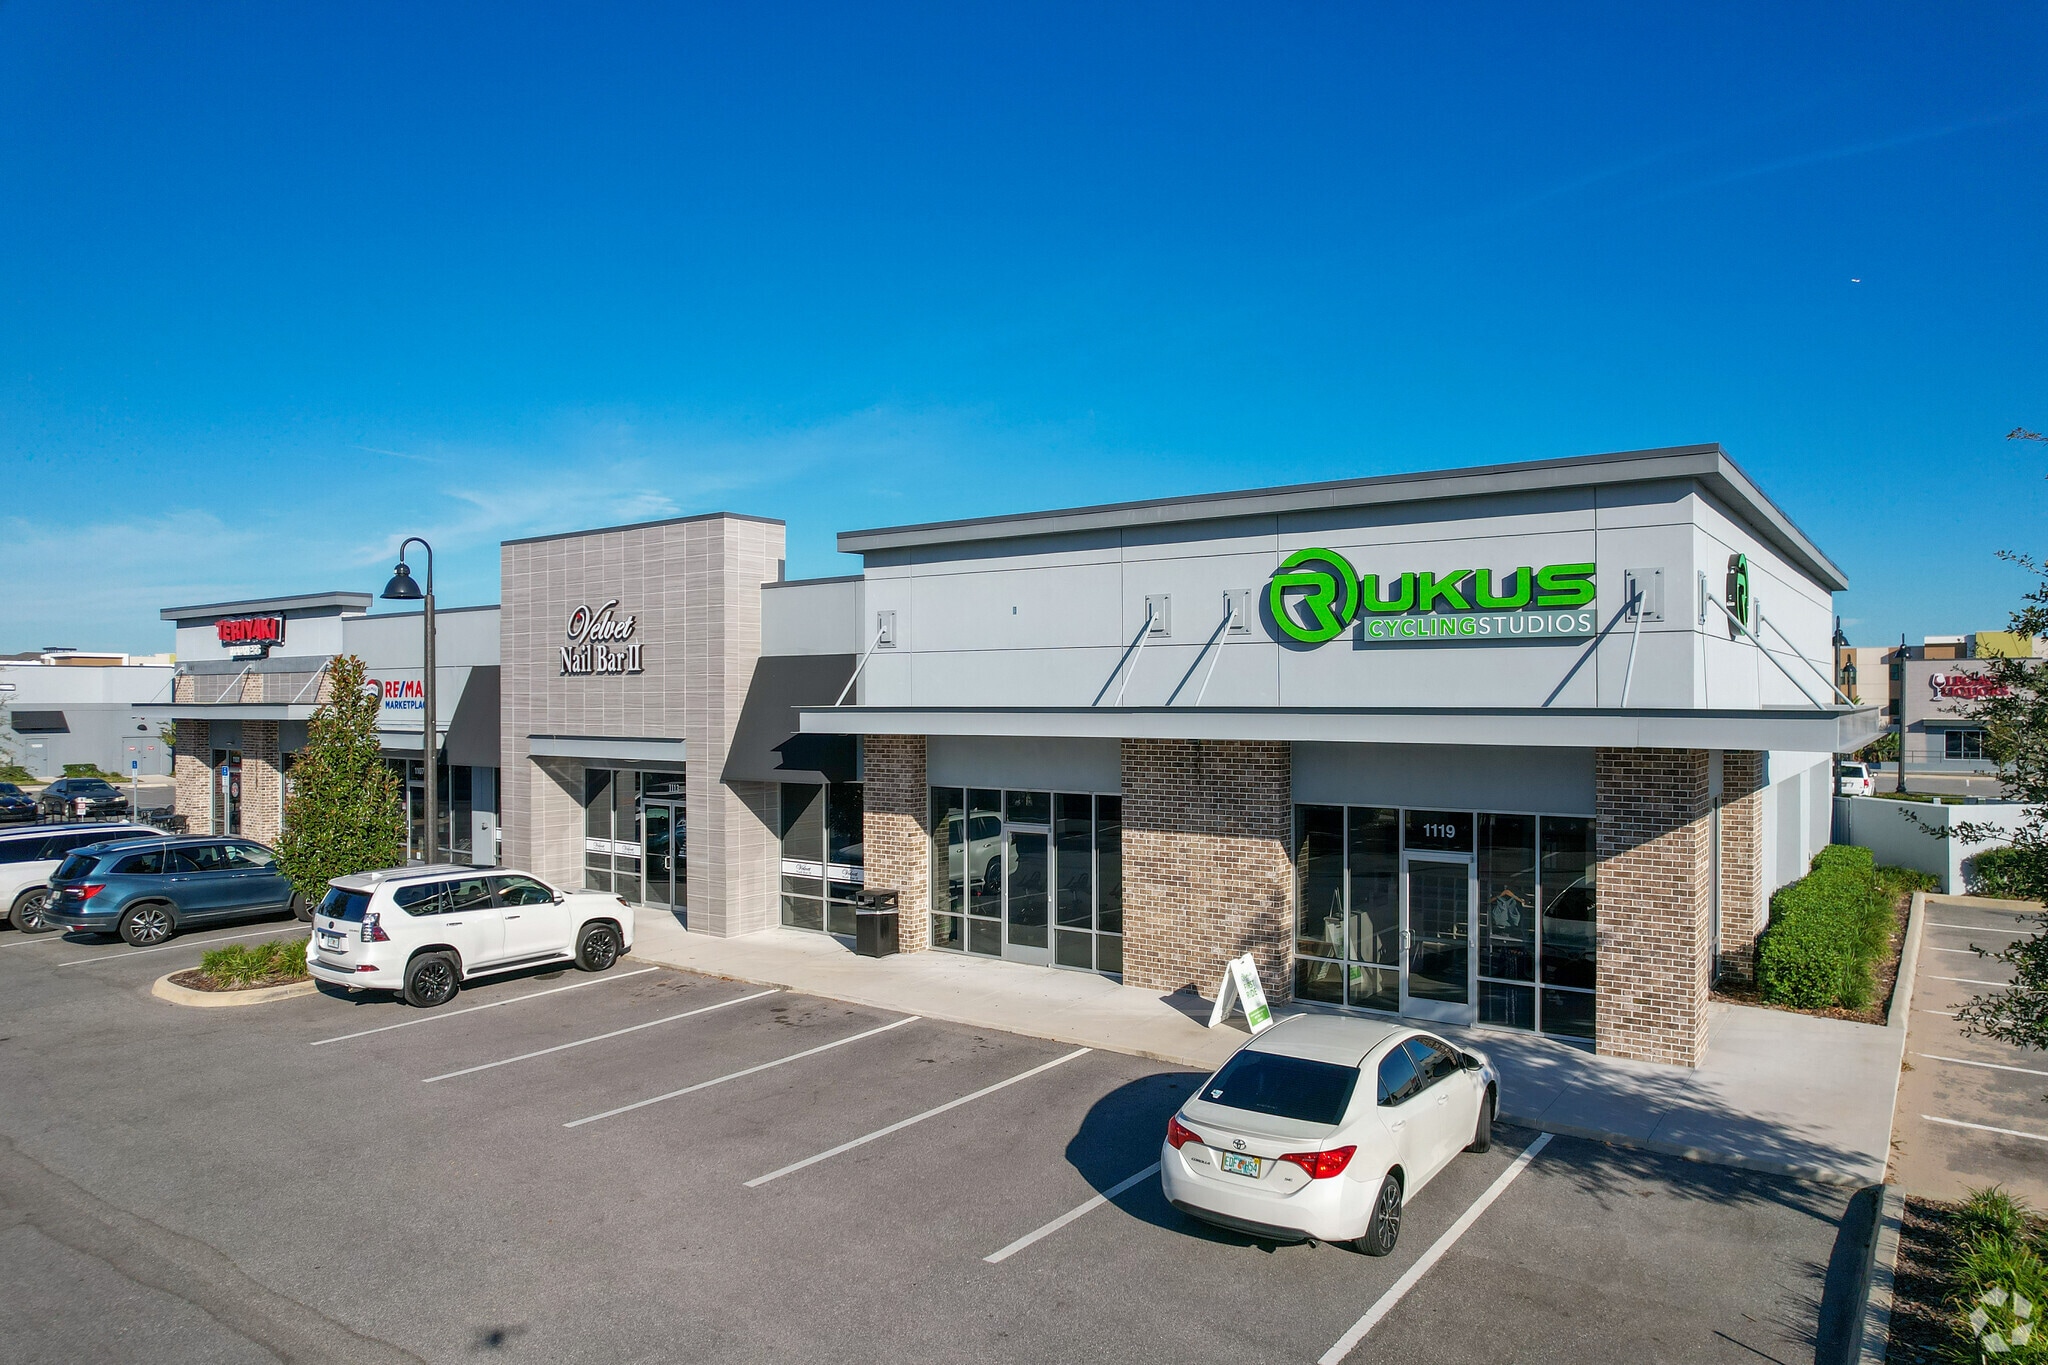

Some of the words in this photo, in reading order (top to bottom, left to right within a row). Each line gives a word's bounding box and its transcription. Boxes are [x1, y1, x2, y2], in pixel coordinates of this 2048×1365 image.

[215, 617, 277, 641] TERIYAKI
[567, 599, 634, 643] Velvet
[560, 645, 593, 674] Nail
[597, 645, 626, 673] Bar
[385, 680, 425, 698] RE/MA
[385, 700, 426, 710] MARKETPLA
[1423, 823, 1456, 838] 1119
